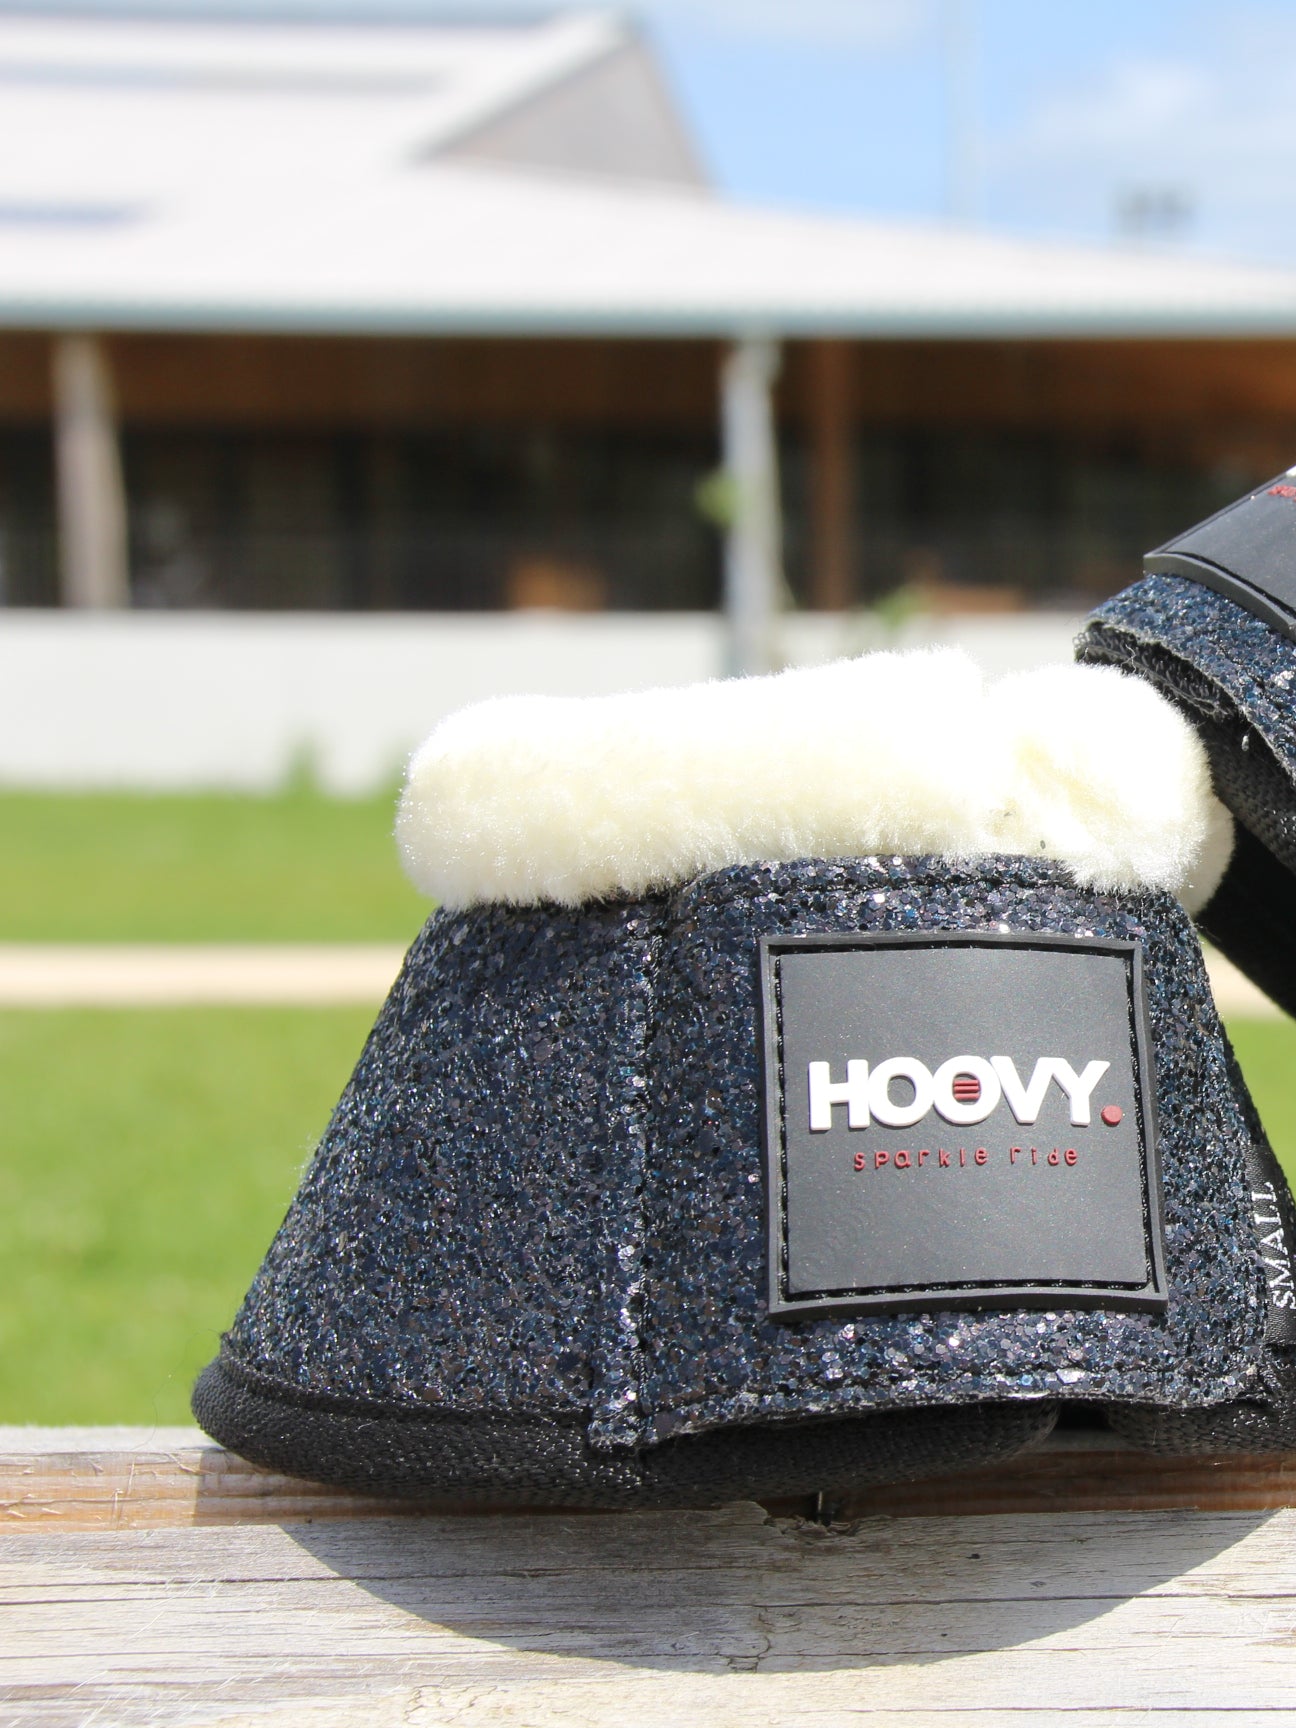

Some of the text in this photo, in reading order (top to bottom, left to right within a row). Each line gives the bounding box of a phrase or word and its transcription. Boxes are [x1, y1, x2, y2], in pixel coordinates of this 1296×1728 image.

[853, 1146, 1078, 1171] sparkle ride
[1251, 1182, 1296, 1310] SMALL
